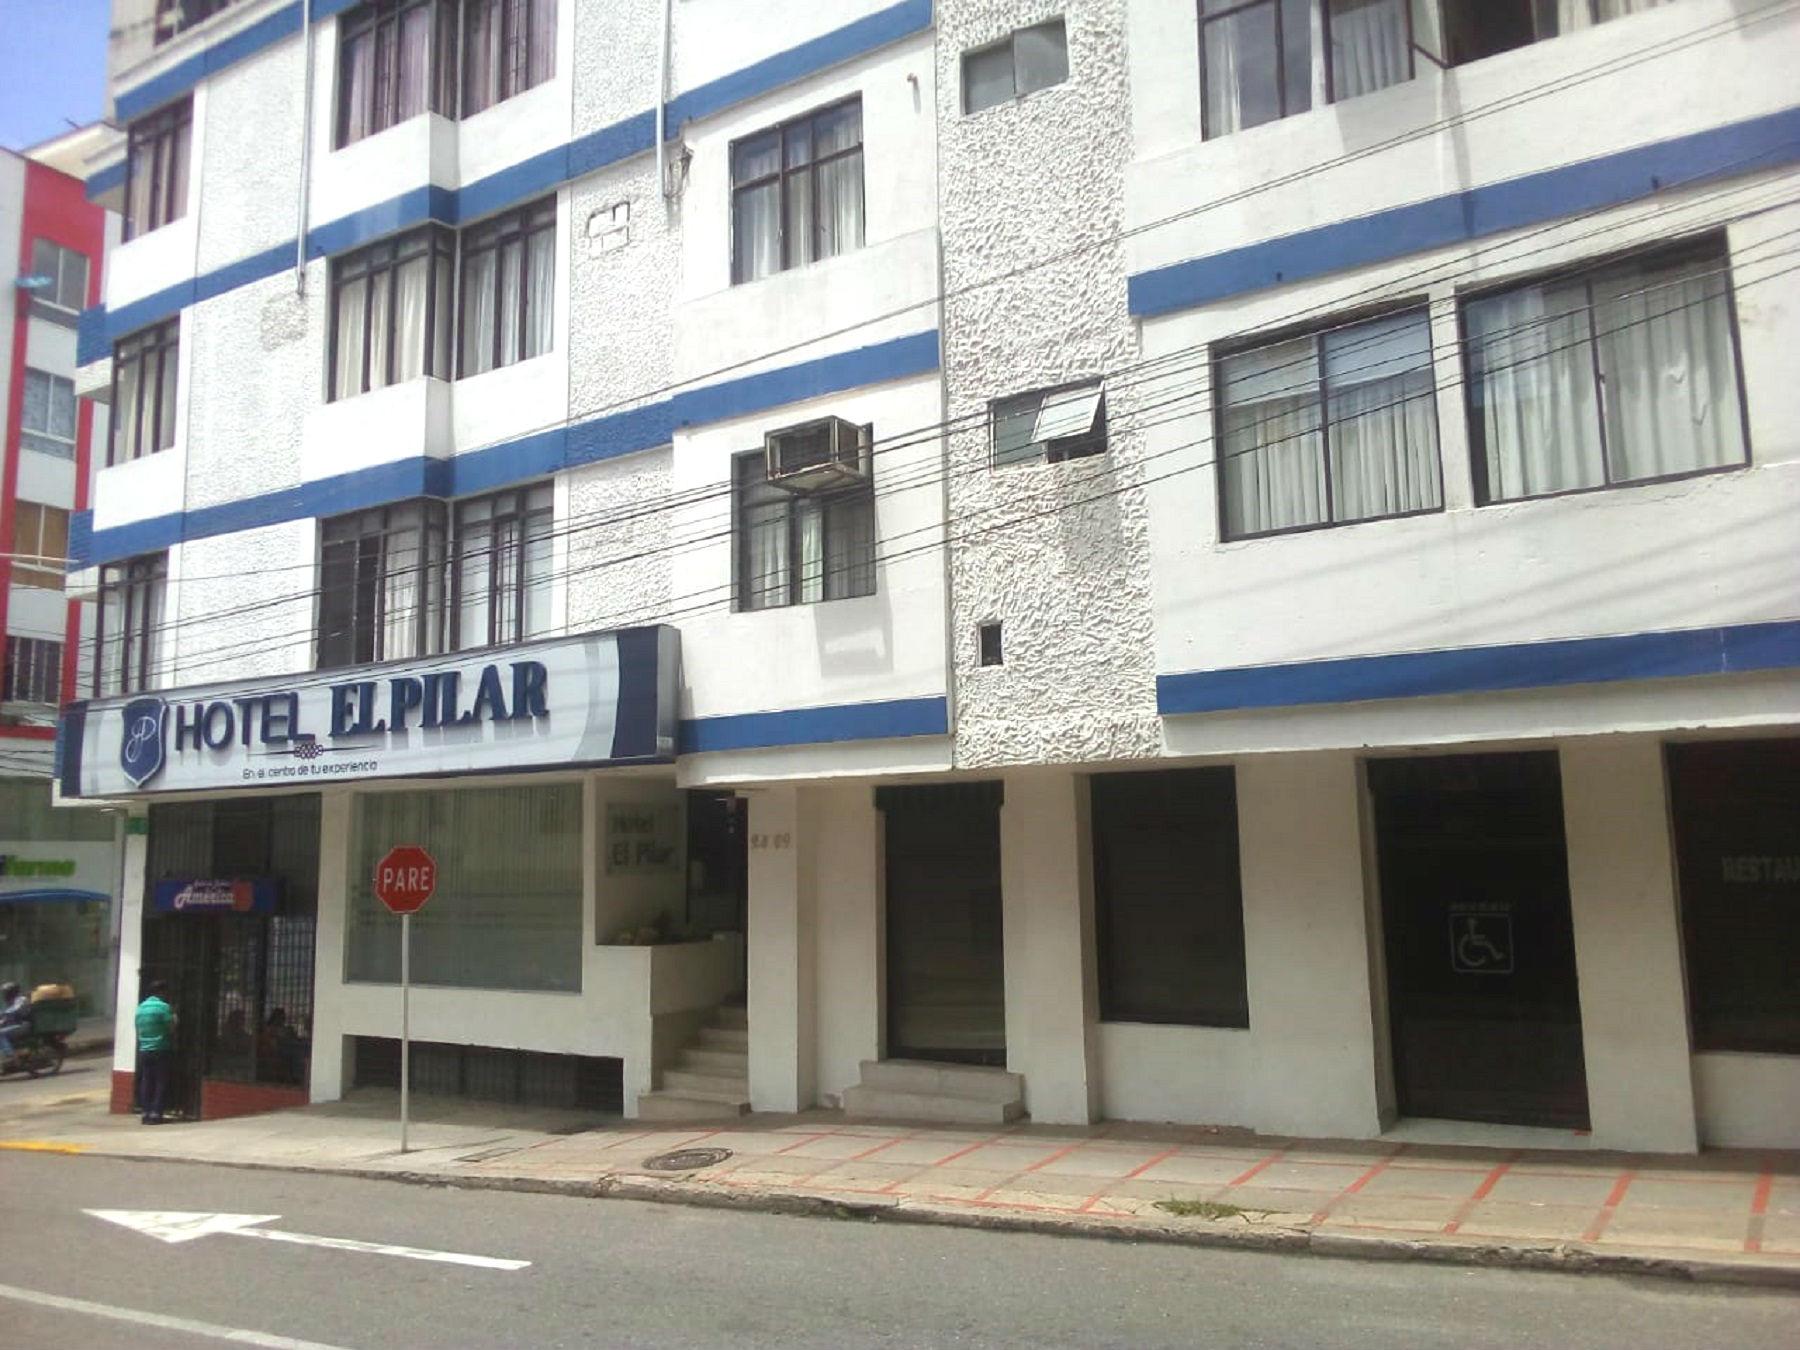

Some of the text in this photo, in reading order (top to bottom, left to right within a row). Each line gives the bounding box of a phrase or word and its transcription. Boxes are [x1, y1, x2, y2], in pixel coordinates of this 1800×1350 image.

[175, 691, 316, 752] HOTEL
[242, 768, 256, 779] En
[268, 766, 296, 777] centro
[297, 765, 309, 776] de
[323, 759, 378, 775] experiencia
[382, 866, 430, 894] PARE
